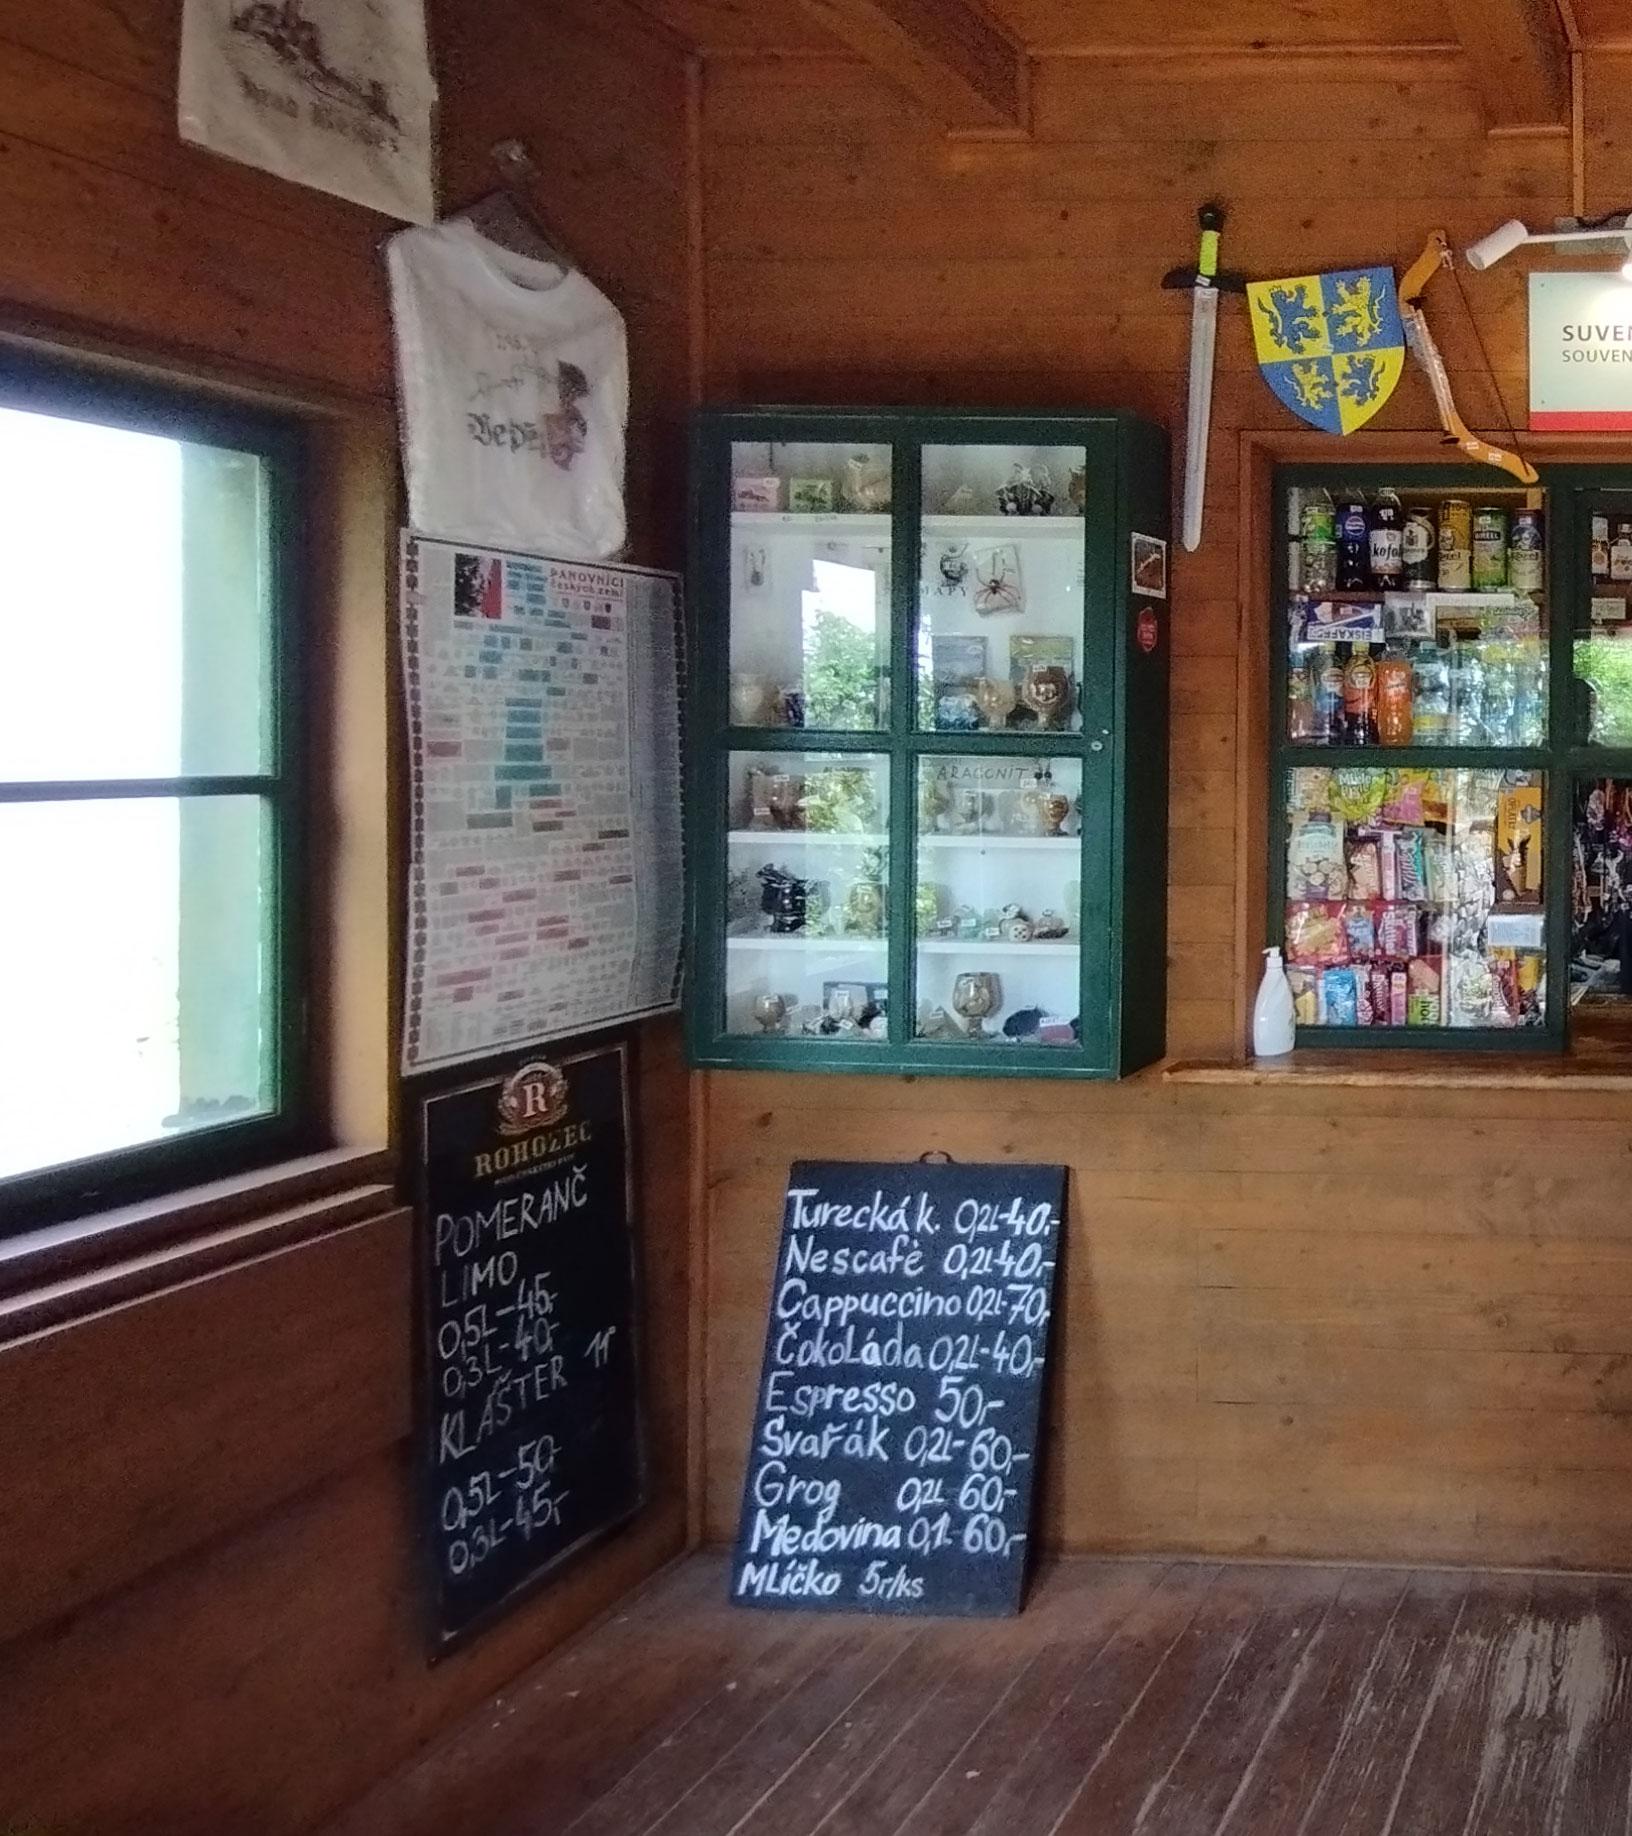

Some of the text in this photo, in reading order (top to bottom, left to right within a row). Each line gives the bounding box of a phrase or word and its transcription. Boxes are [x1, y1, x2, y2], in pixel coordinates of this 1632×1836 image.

[936, 765, 1030, 781] ARAGONIT
[522, 1082, 549, 1118] R
[473, 1120, 592, 1177] ROHOZEC
[435, 1162, 588, 1266] POMERANČ
[441, 1250, 518, 1308] LIMO
[776, 1278, 962, 1327] Cappuccino
[765, 1371, 916, 1417] Espresso
[761, 1414, 889, 1462] Svařák
[754, 1460, 841, 1523] Grog
[750, 1508, 901, 1557] Medovina
